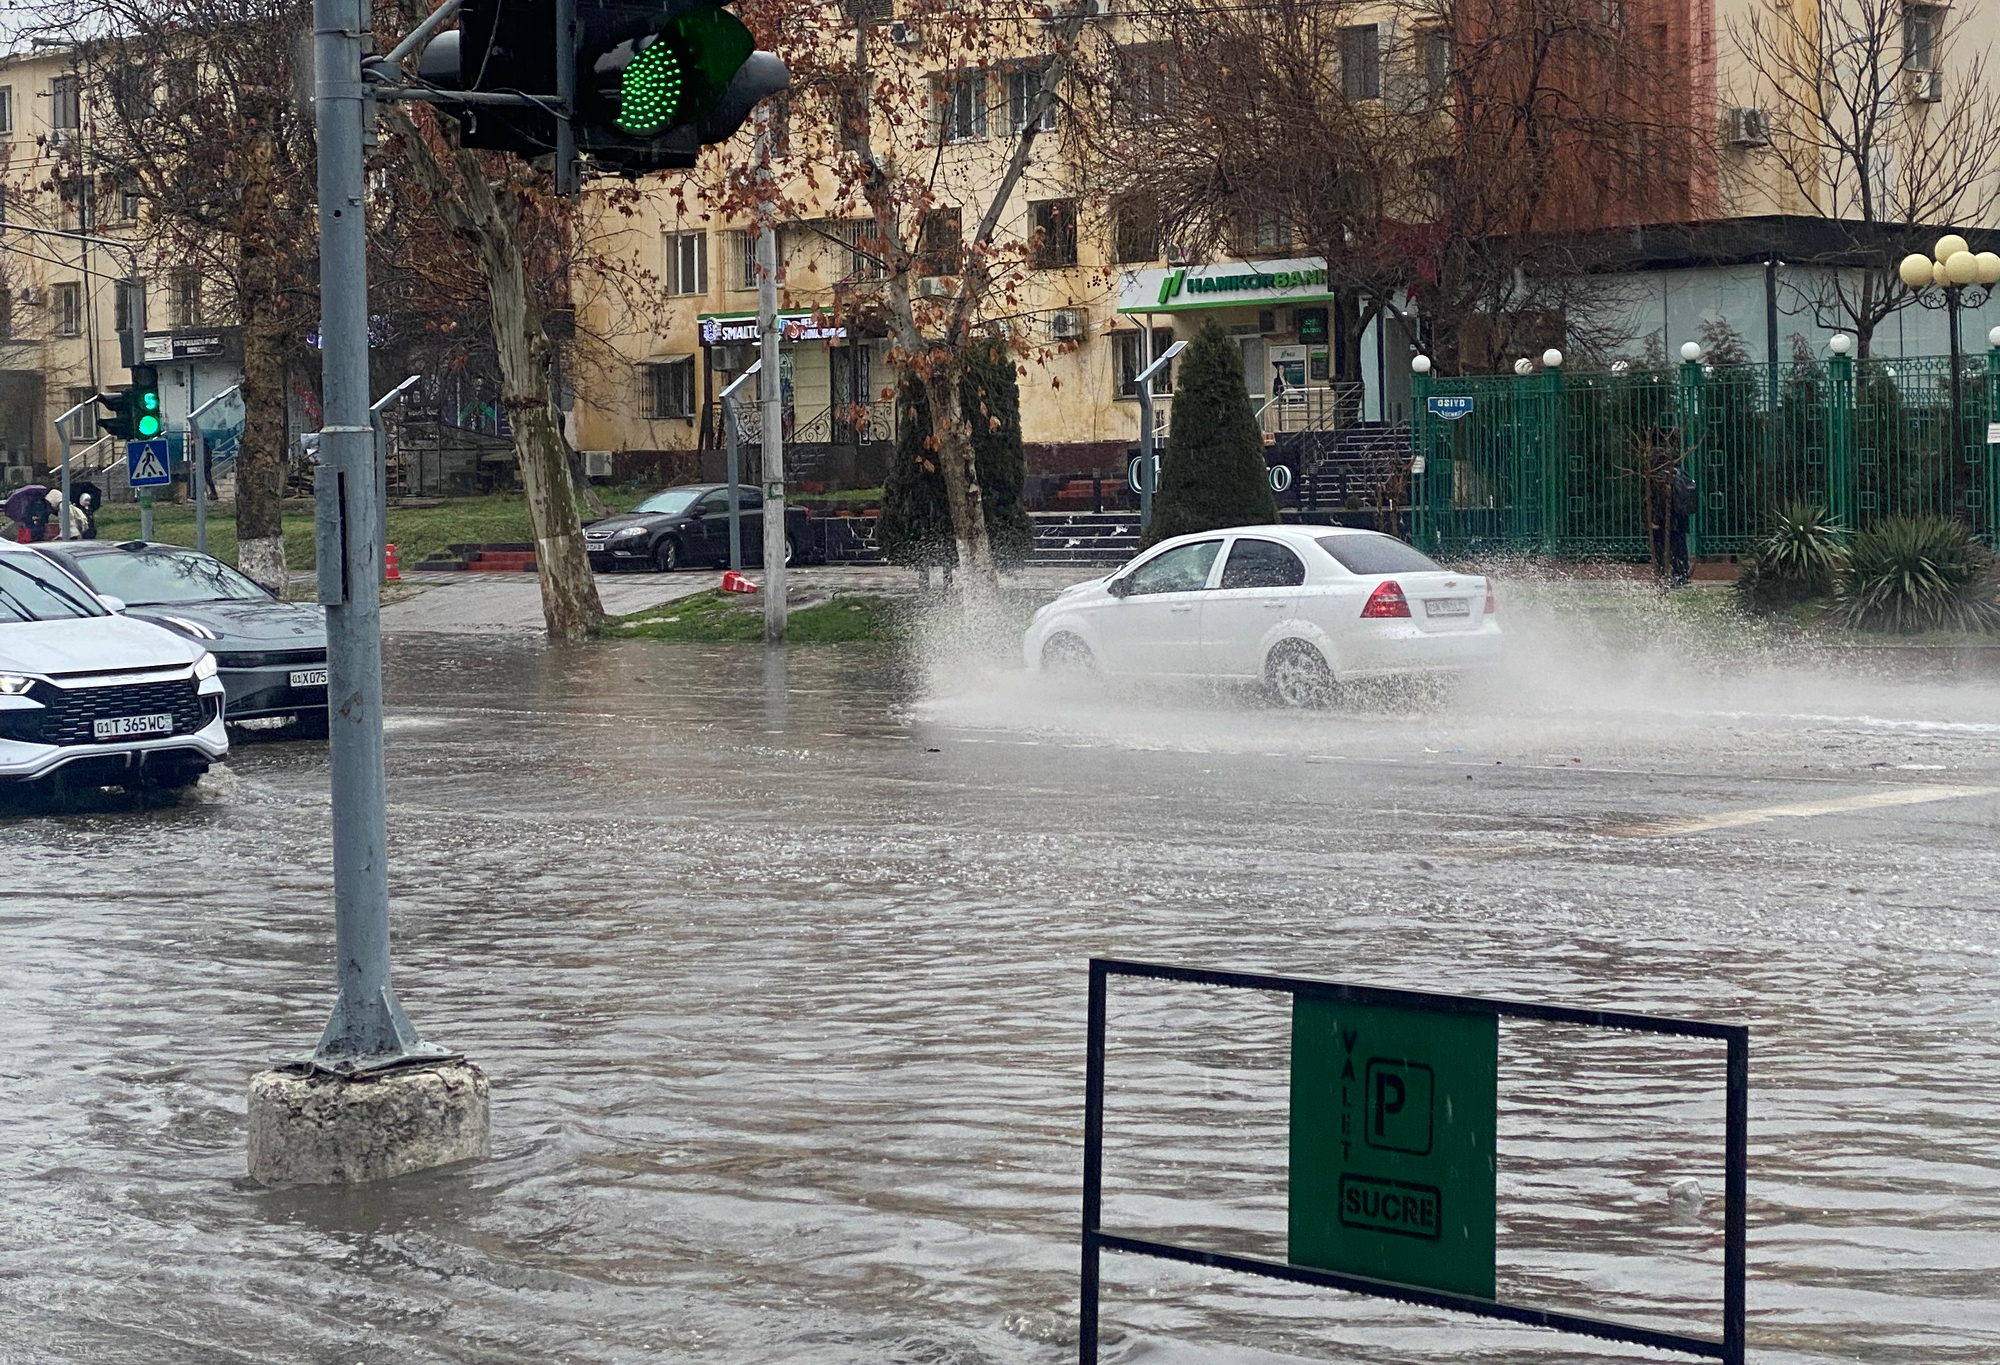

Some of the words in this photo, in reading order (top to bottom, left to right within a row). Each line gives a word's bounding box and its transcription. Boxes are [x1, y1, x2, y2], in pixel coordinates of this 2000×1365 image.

[97, 722, 110, 734] 01
[1340, 1030, 1358, 1162] VALET
[1375, 1072, 1406, 1136] P
[1346, 1186, 1435, 1228] SUCRE
